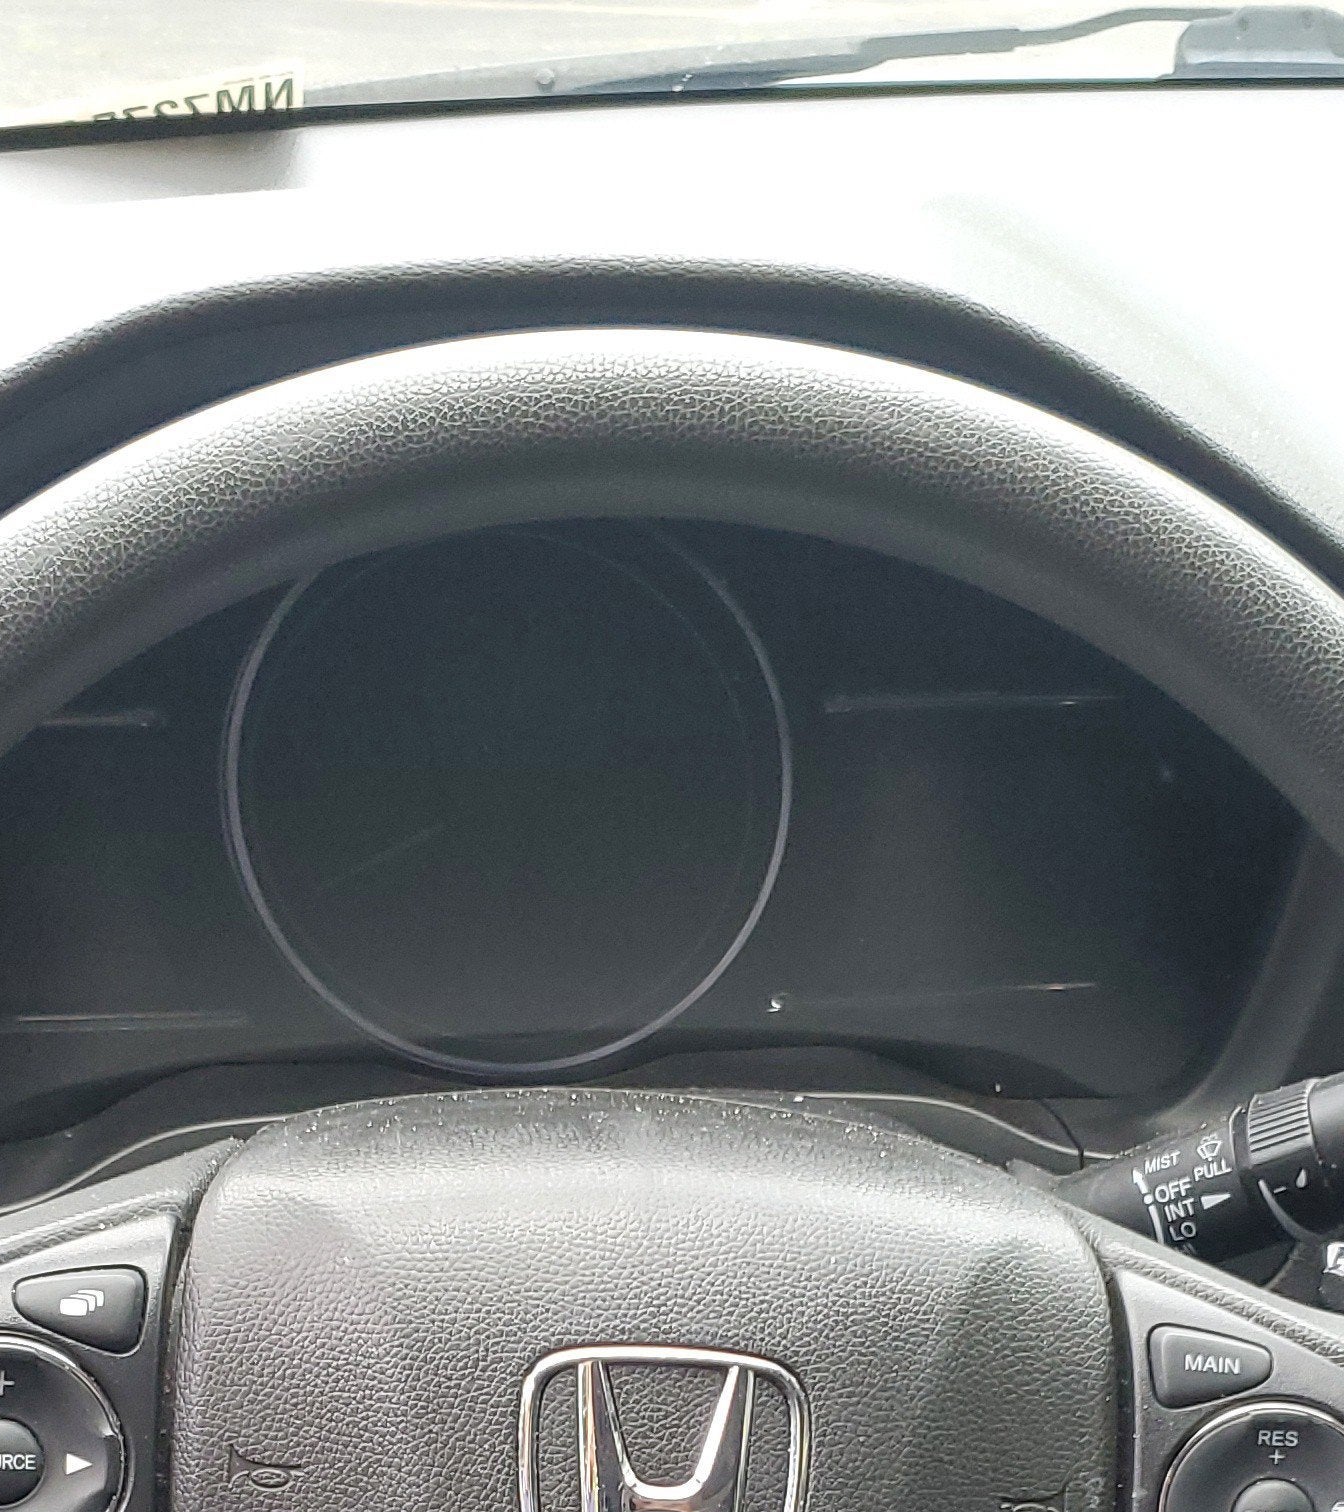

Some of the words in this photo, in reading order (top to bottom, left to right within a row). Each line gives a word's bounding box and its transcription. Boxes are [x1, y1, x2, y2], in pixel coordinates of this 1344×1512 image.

[1145, 1151, 1181, 1175] MIST
[1193, 1158, 1233, 1181] PULL
[1155, 1176, 1192, 1203] OFF
[1164, 1198, 1195, 1222] INT
[1169, 1222, 1197, 1241] LO
[1183, 1354, 1241, 1375] MAIN
[1257, 1429, 1299, 1448] RES
